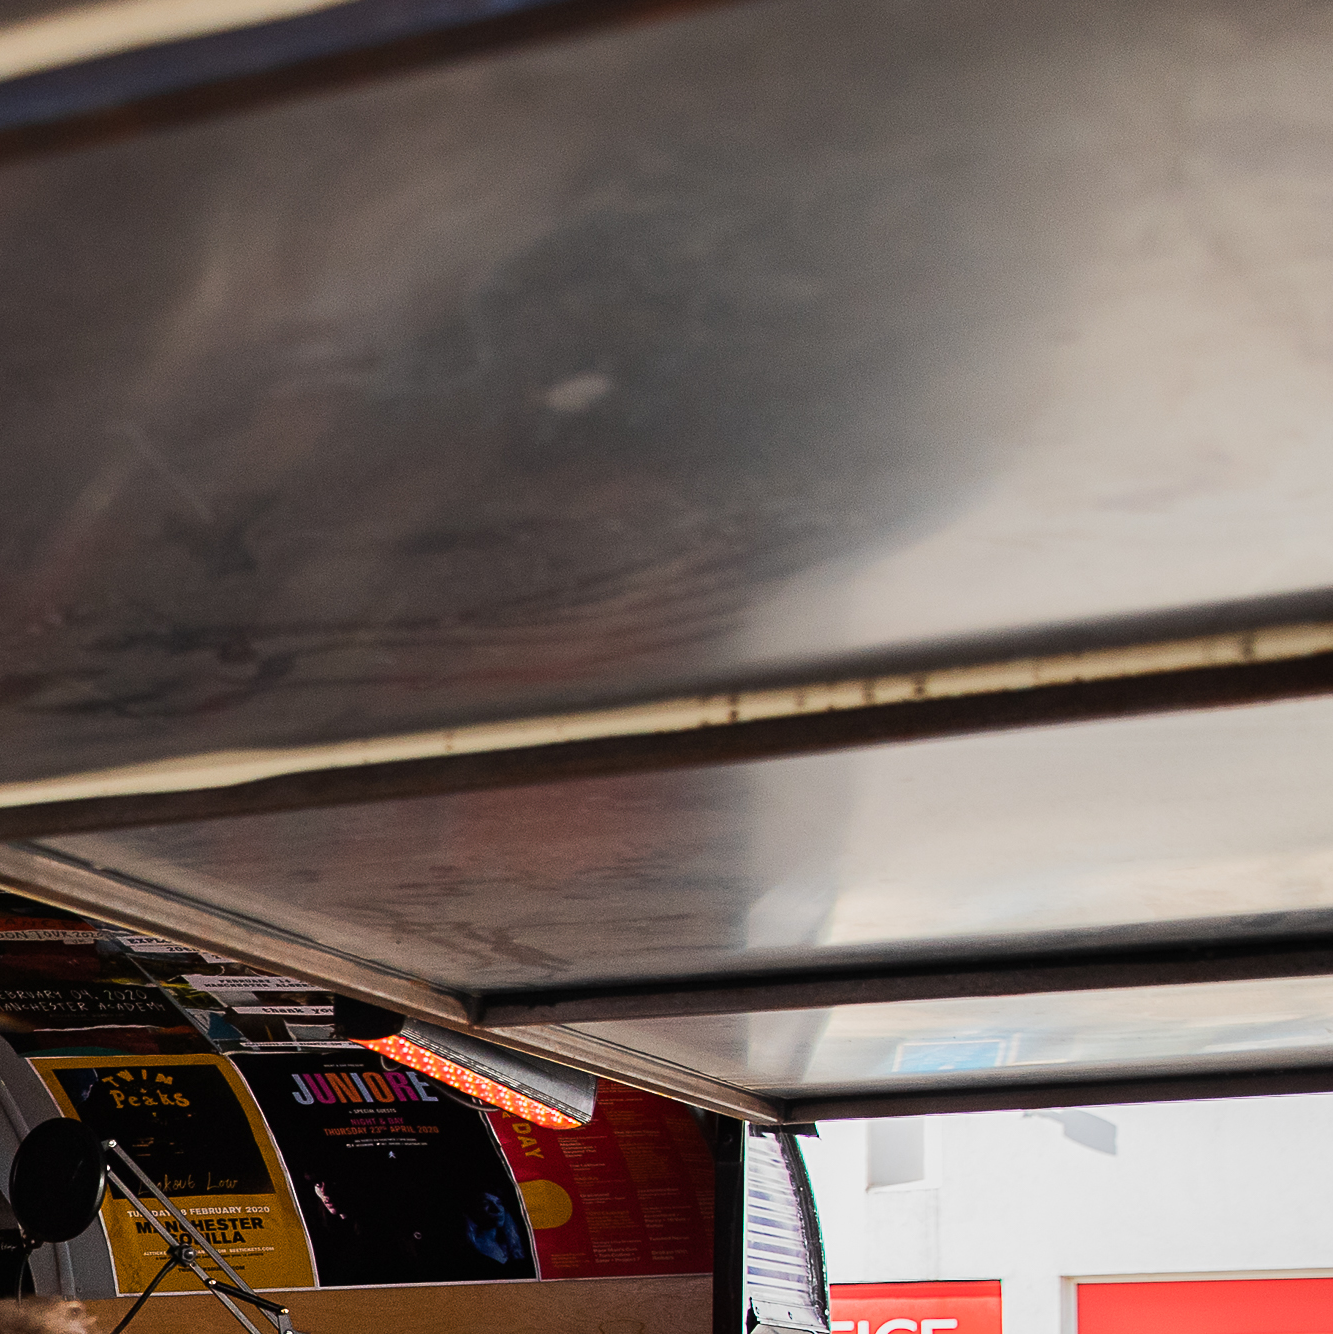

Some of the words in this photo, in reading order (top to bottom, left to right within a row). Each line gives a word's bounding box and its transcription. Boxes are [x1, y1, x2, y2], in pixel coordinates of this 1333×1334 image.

[107, 988, 148, 1001] 2020
[97, 1000, 167, 1013] ACADEMY
[262, 1006, 306, 1015] thank
[291, 1071, 439, 1105] JUNIORE
[350, 1117, 377, 1126] NIGHT
[323, 1126, 368, 1137] THURSDAY
[390, 1125, 416, 1134] APRIL
[417, 1125, 440, 1134] 2020
[511, 1122, 545, 1160] DAY
[207, 1171, 239, 1191] Low
[190, 1206, 242, 1216] FEBRUARY
[245, 1205, 271, 1214] 2020
